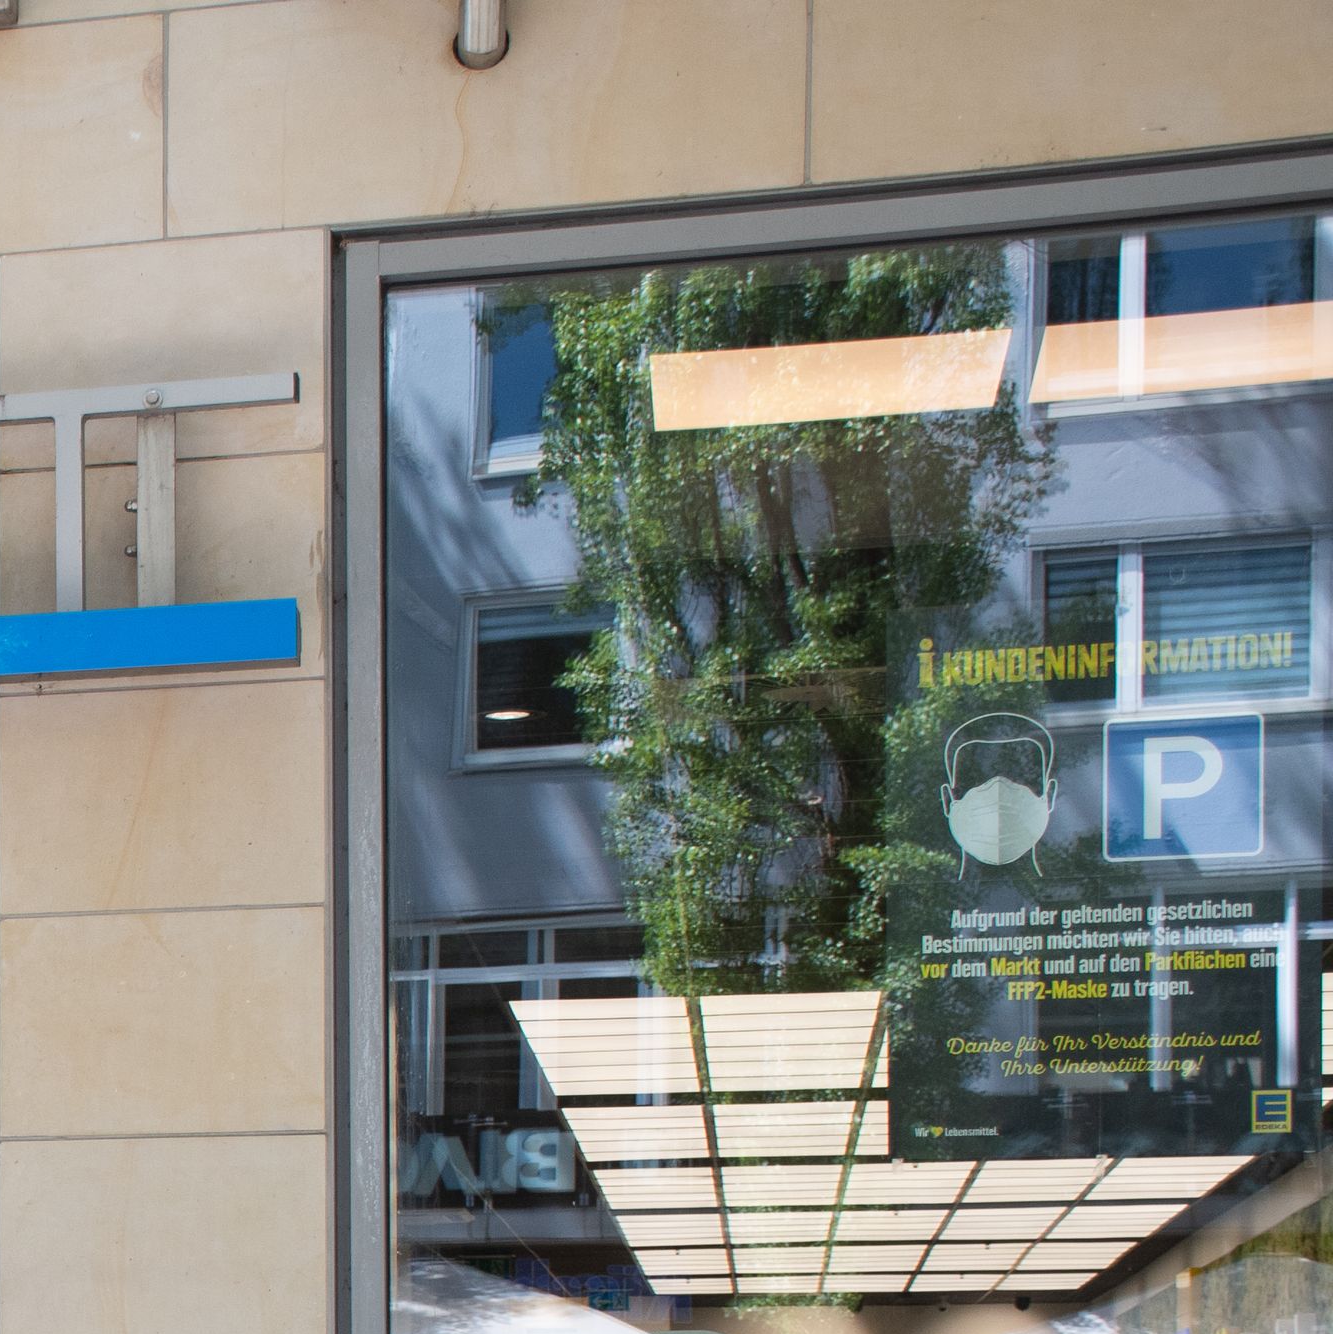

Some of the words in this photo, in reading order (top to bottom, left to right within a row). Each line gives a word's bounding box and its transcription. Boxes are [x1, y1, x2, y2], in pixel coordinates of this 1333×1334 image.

[942, 632, 1292, 686] KUNDENINFRMATION!
[1143, 736, 1223, 840] P
[951, 909, 1024, 930] Aufgrund
[1029, 908, 1056, 926] der
[1061, 905, 1141, 926] geltenden
[1147, 900, 1253, 925] gesetzlichen
[922, 934, 1042, 955] Bestimmungen
[1047, 932, 1118, 950] möchten
[1123, 930, 1148, 947] wir
[1154, 928, 1179, 946] Sie
[1184, 927, 1237, 947] bitten,
[921, 963, 947, 979] vor
[951, 959, 986, 978] dem
[990, 957, 1040, 976] Markt
[1044, 956, 1074, 974] und
[1079, 954, 1106, 974] auf
[1110, 953, 1140, 972] den
[1144, 950, 1246, 971] Parkflächen
[1250, 948, 1285, 967] eine
[1008, 979, 1107, 1000] FFP2-Maske
[1111, 982, 1129, 997] zu
[1134, 978, 1194, 1000] tragen.
[947, 1034, 1012, 1055] Danke
[1015, 1036, 1048, 1060] für
[1053, 1034, 1087, 1052] Ihr
[1092, 1032, 1217, 1051] Verständnis
[1220, 1030, 1261, 1047] und
[1001, 1058, 1046, 1078] Ihre
[1050, 1056, 1203, 1078] Unterstützung!
[915, 1126, 929, 1137] Wir
[945, 1125, 999, 1137] Lebensmittel.
[1255, 1123, 1287, 1131] EDEKA
